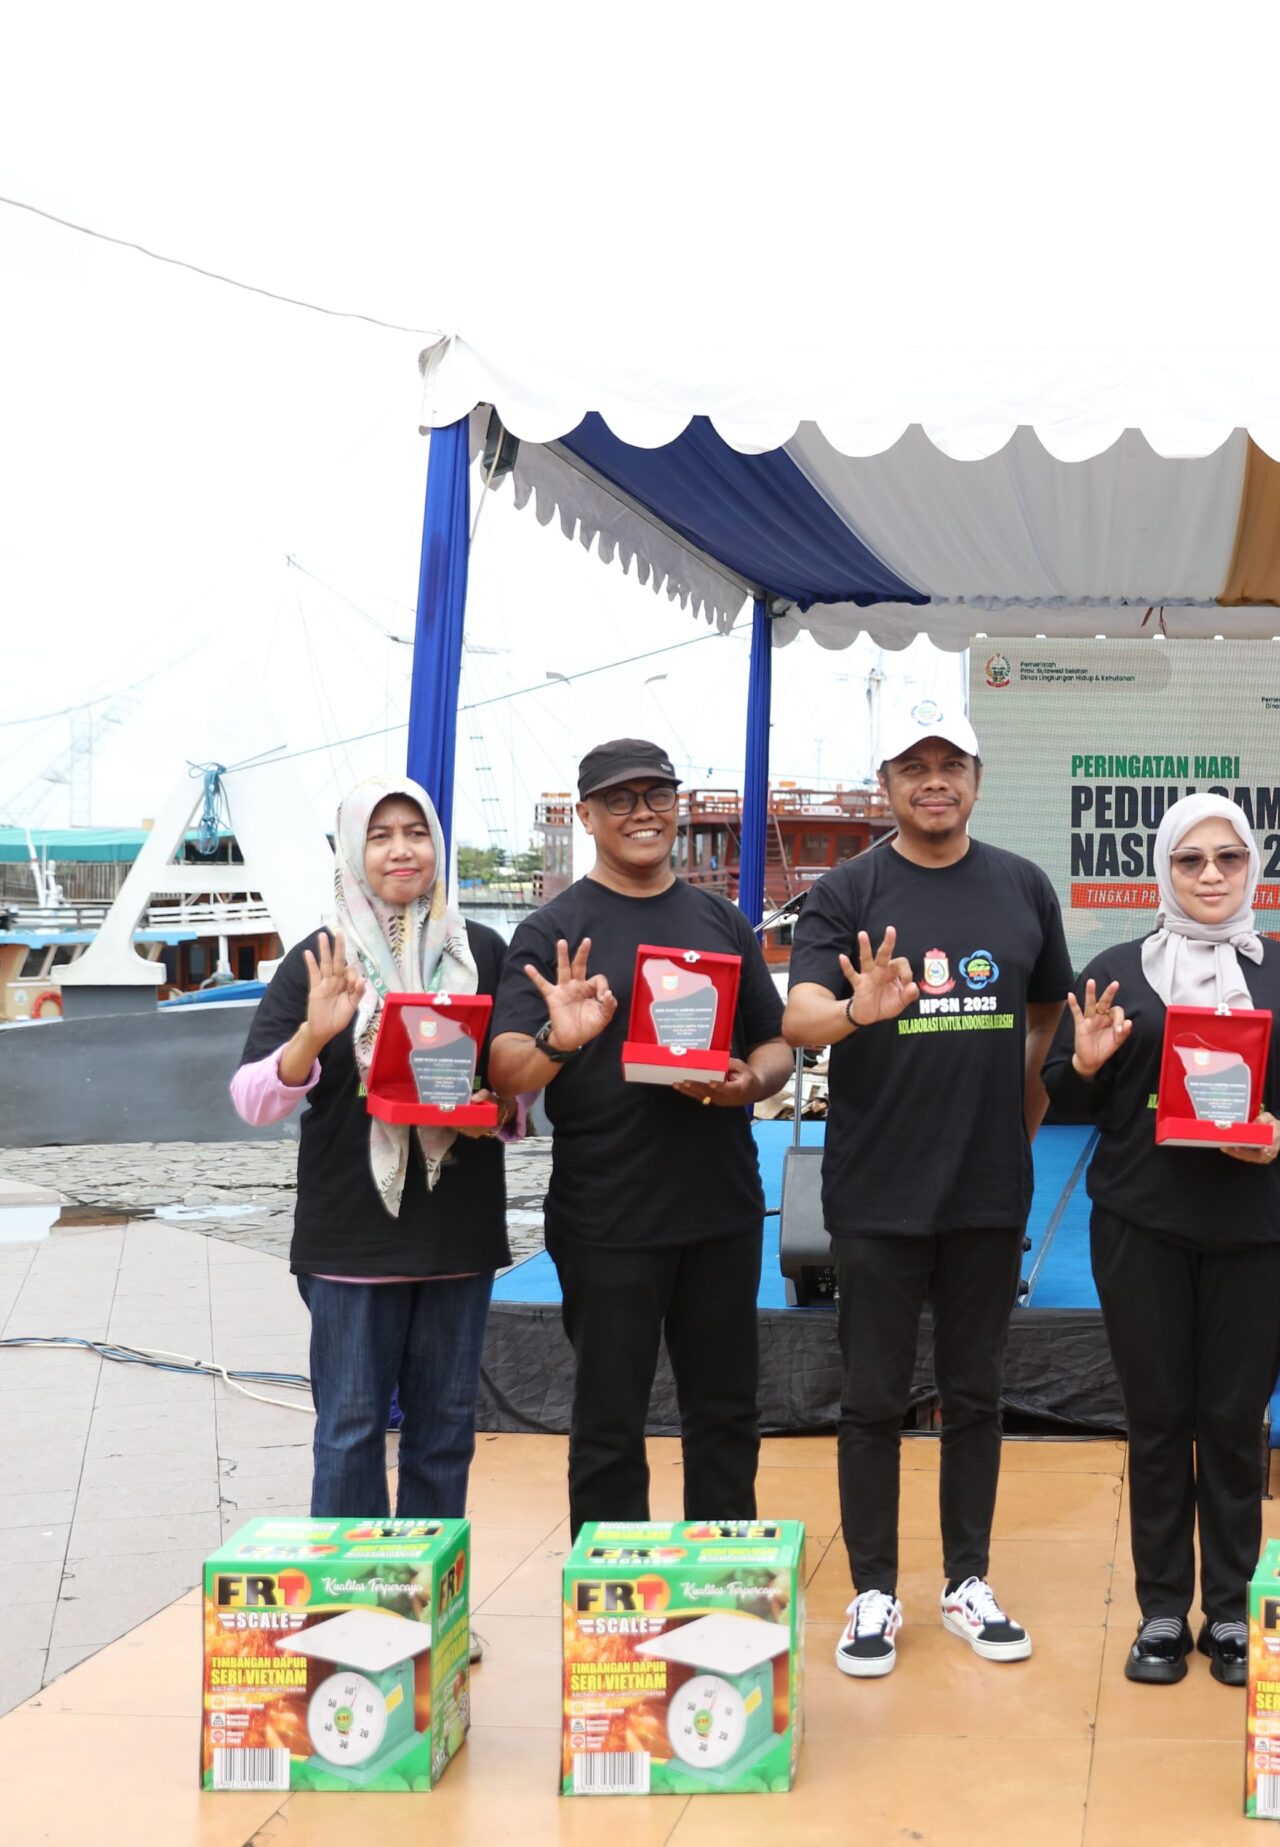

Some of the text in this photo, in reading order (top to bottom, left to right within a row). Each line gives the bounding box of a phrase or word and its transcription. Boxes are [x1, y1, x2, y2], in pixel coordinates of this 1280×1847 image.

[1039, 675, 1075, 683] Lingkungan
[1076, 675, 1094, 683] Hidup
[1071, 754, 1240, 779] PERINGATAN HARI
[1070, 832, 1158, 877] NASI
[1087, 889, 1138, 904] TINGKAT
[919, 996, 997, 1014] HPSN 2025
[898, 1016, 939, 1035] KOLABORASI
[939, 1016, 962, 1032] UNTUK
[217, 1574, 305, 1606] FRT
[321, 1576, 365, 1598] Kualitas
[681, 1581, 726, 1600] Kualitas
[576, 1580, 664, 1612] FRT
[236, 1613, 291, 1630] SCALE
[595, 1617, 650, 1634] SCALE
[211, 1656, 308, 1669] TIMBANGAN DAPUR
[571, 1661, 667, 1674] TIMBANGAN DAPUR
[211, 1669, 308, 1685] SERI VIETNAM
[570, 1674, 667, 1691] SERI VIETNAM
